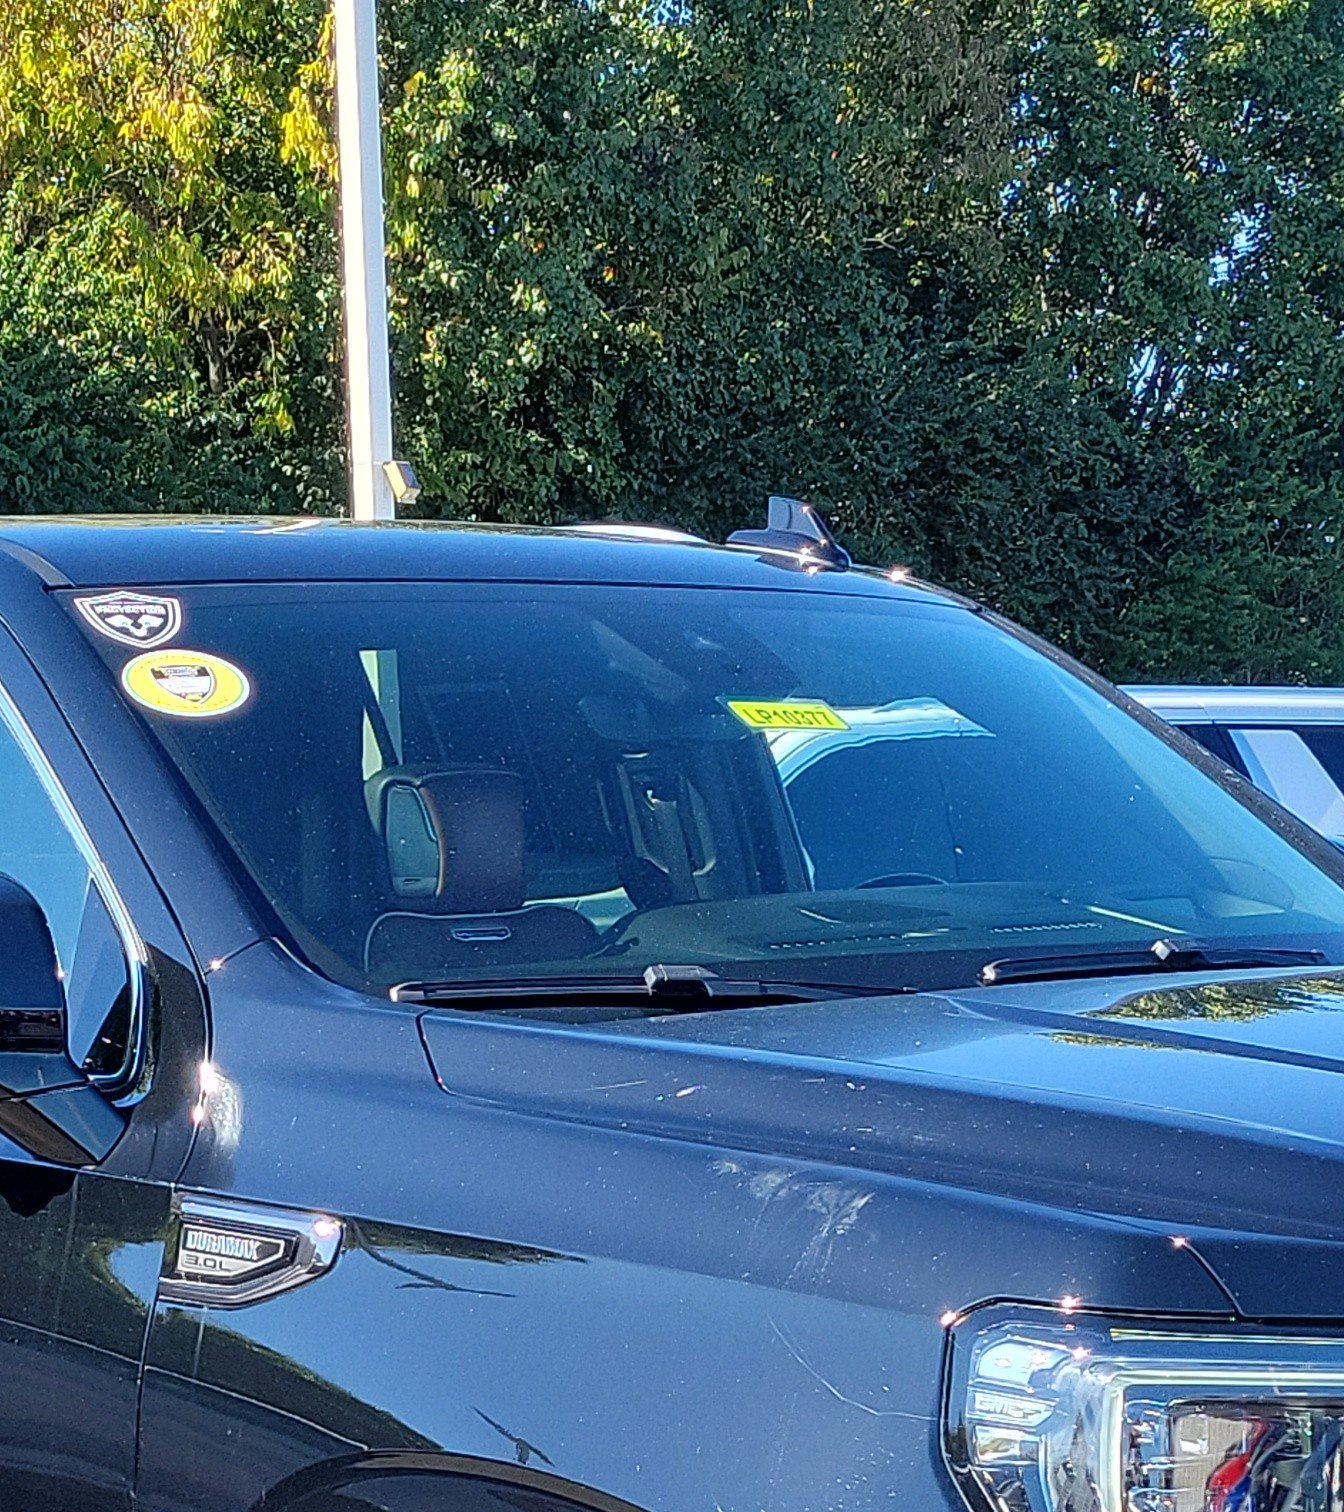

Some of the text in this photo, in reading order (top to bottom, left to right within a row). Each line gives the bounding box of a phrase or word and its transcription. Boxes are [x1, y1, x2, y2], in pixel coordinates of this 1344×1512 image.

[743, 707, 834, 726] LP10377
[186, 1230, 263, 1260] DURAMAX
[184, 1254, 231, 1271] 3.0L
